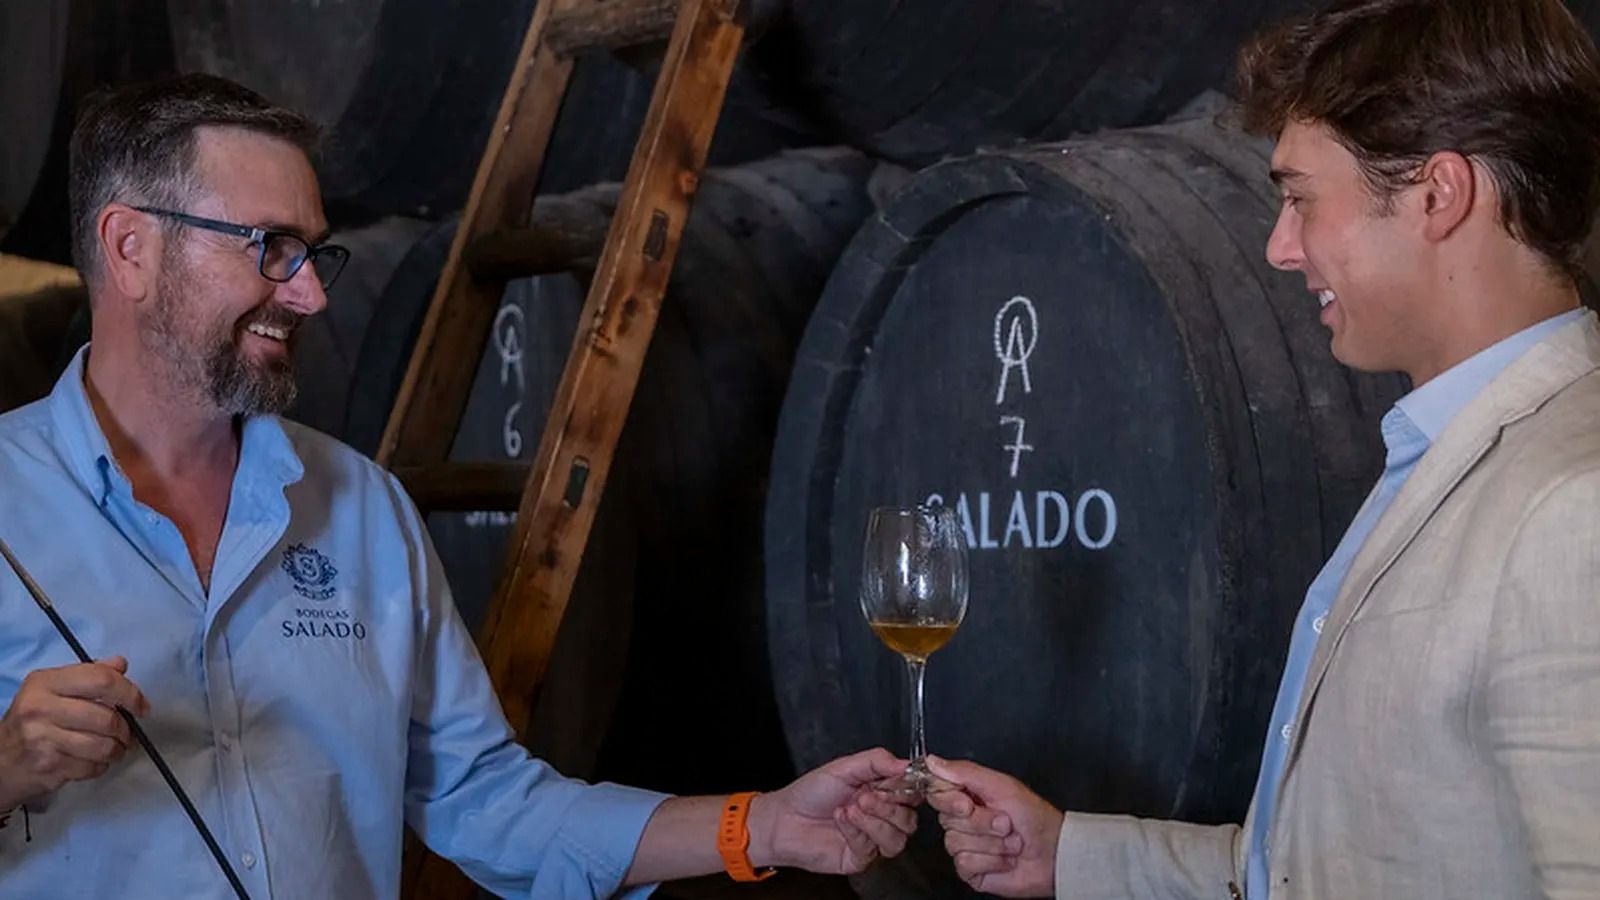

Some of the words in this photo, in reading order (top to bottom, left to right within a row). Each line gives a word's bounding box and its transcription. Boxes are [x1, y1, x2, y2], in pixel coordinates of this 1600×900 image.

[503, 400, 523, 458] 6
[999, 415, 1034, 478] 7
[281, 620, 366, 640] SALADO
[295, 608, 350, 619] BODEGAS
